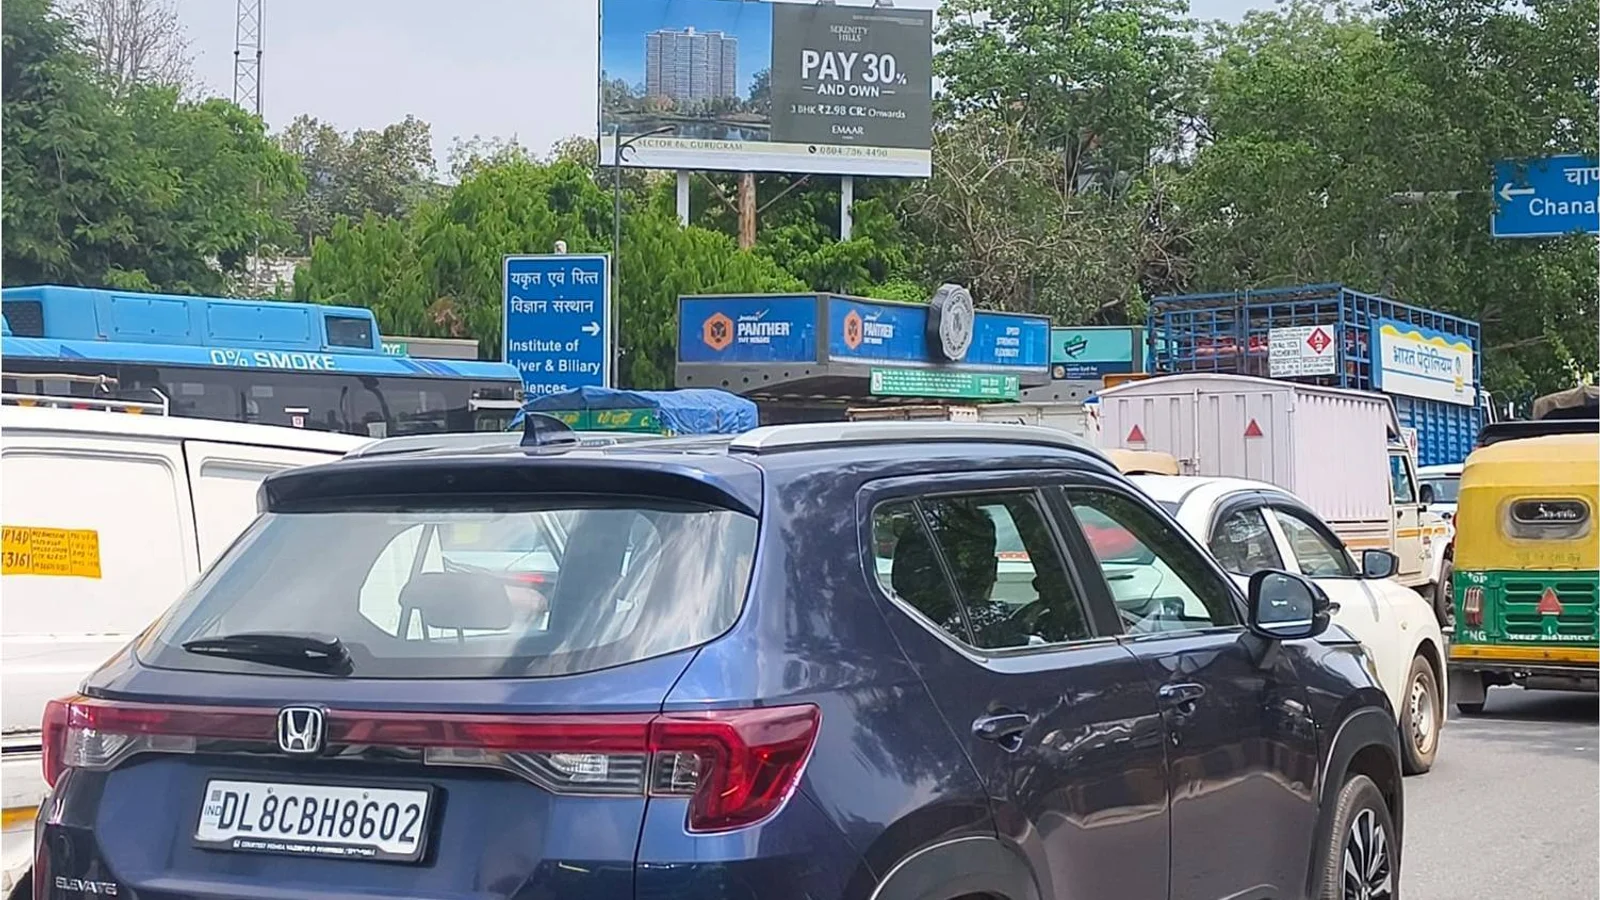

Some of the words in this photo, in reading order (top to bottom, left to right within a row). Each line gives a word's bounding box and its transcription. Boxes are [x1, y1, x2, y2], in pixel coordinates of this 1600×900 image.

[801, 49, 858, 81] PAY
[862, 53, 907, 85] 30%
[817, 83, 845, 96] AND
[848, 84, 880, 97] OWN
[798, 105, 816, 115] BHK
[818, 104, 846, 116] ₹2.98
[868, 108, 906, 119] Onwards
[832, 125, 864, 135] EMAAR
[637, 139, 672, 148] SECTOR
[690, 140, 743, 150] GURUGRAM
[1529, 198, 1599, 216] Chana
[510, 272, 541, 290] यकृत
[547, 267, 565, 287] एवं
[571, 267, 598, 285] पित्त
[511, 296, 547, 313] विज्ञान
[552, 295, 593, 313] संस्थान
[737, 322, 790, 336] PANTHER
[864, 322, 893, 338] PANTHER
[509, 339, 561, 352] Institute
[565, 339, 579, 352] of
[210, 349, 248, 367] 0%
[254, 352, 335, 370] SMOKE
[1393, 346, 1415, 366] भारत
[544, 359, 554, 372] &
[558, 360, 600, 375] Biliary
[523, 381, 567, 394] iences
[204, 805, 222, 817] IND
[217, 790, 420, 844] DL8CBH8602
[56, 876, 117, 896] ELEVATE
